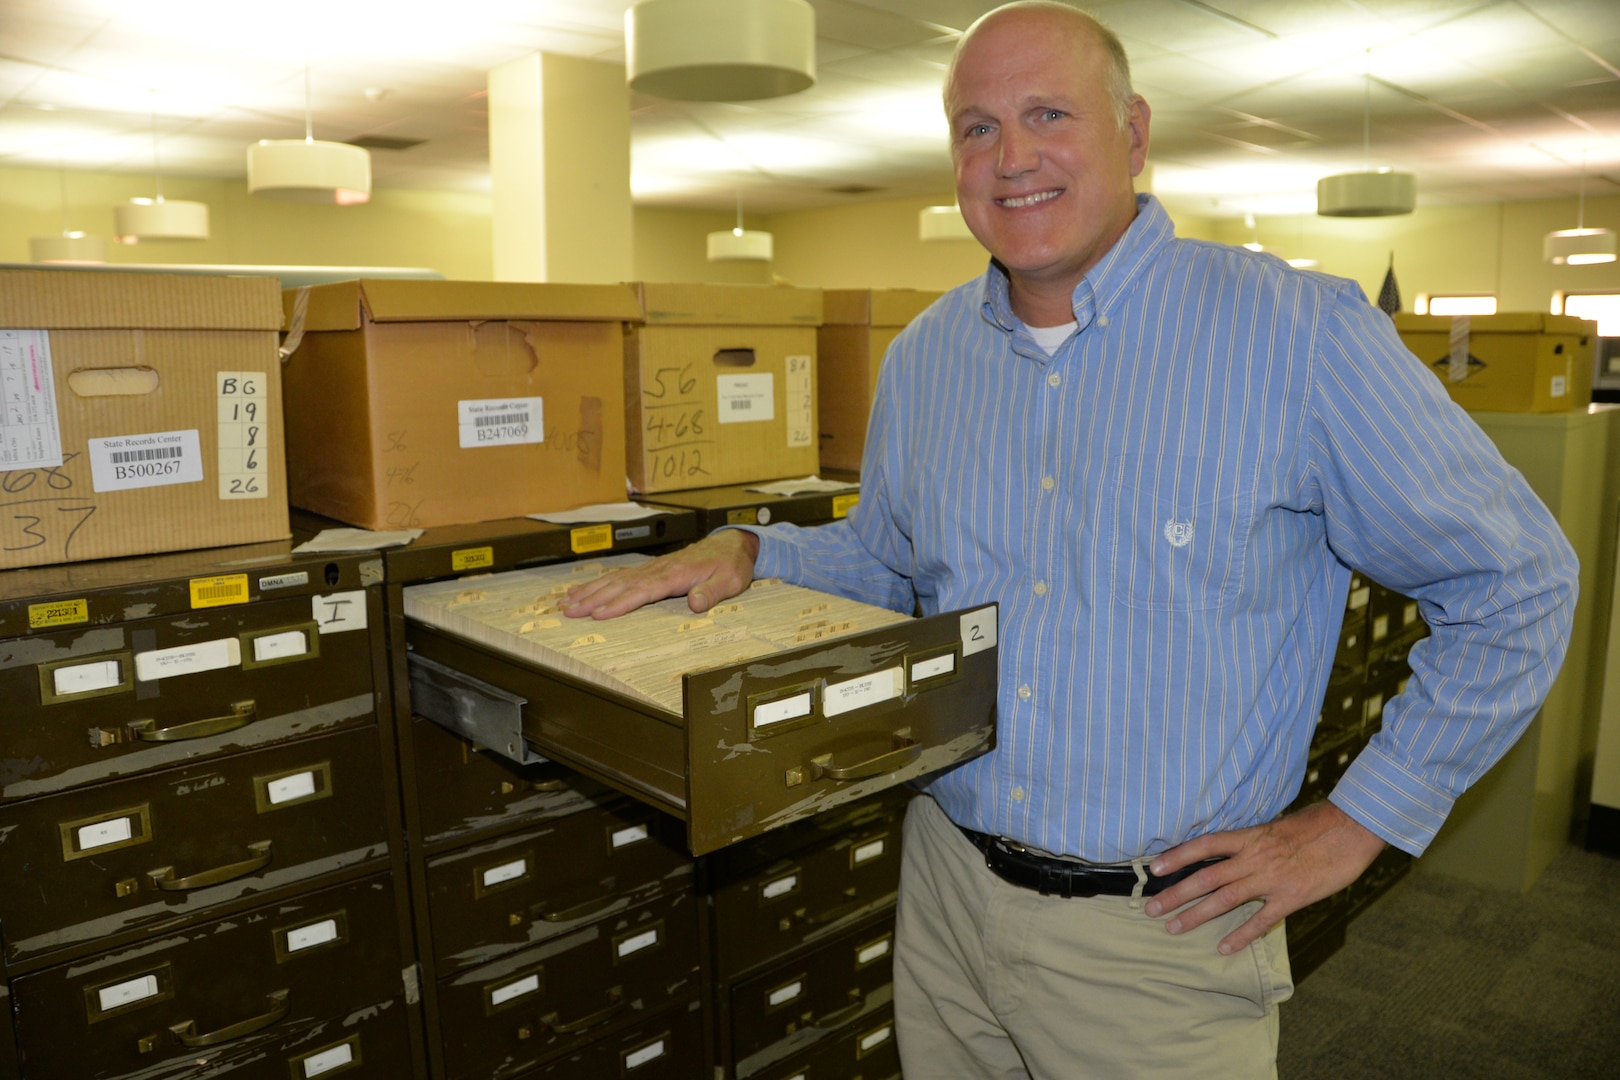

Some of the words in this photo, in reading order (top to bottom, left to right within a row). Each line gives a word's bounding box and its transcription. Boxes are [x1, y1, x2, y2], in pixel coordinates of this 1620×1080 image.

[643, 362, 696, 398] 56
[233, 402, 256, 421] 19
[248, 426, 259, 446] 8
[477, 424, 528, 441] B247069
[647, 410, 703, 442] 4-68
[103, 440, 123, 449] State
[125, 437, 156, 447] Records
[157, 435, 182, 444] Center
[246, 449, 257, 469] 6
[651, 449, 712, 483] 1012
[115, 460, 181, 480] B500267
[229, 477, 259, 493] 26
[3, 506, 96, 560] 37
[261, 579, 284, 588] DMNA
[970, 625, 985, 641] 2
